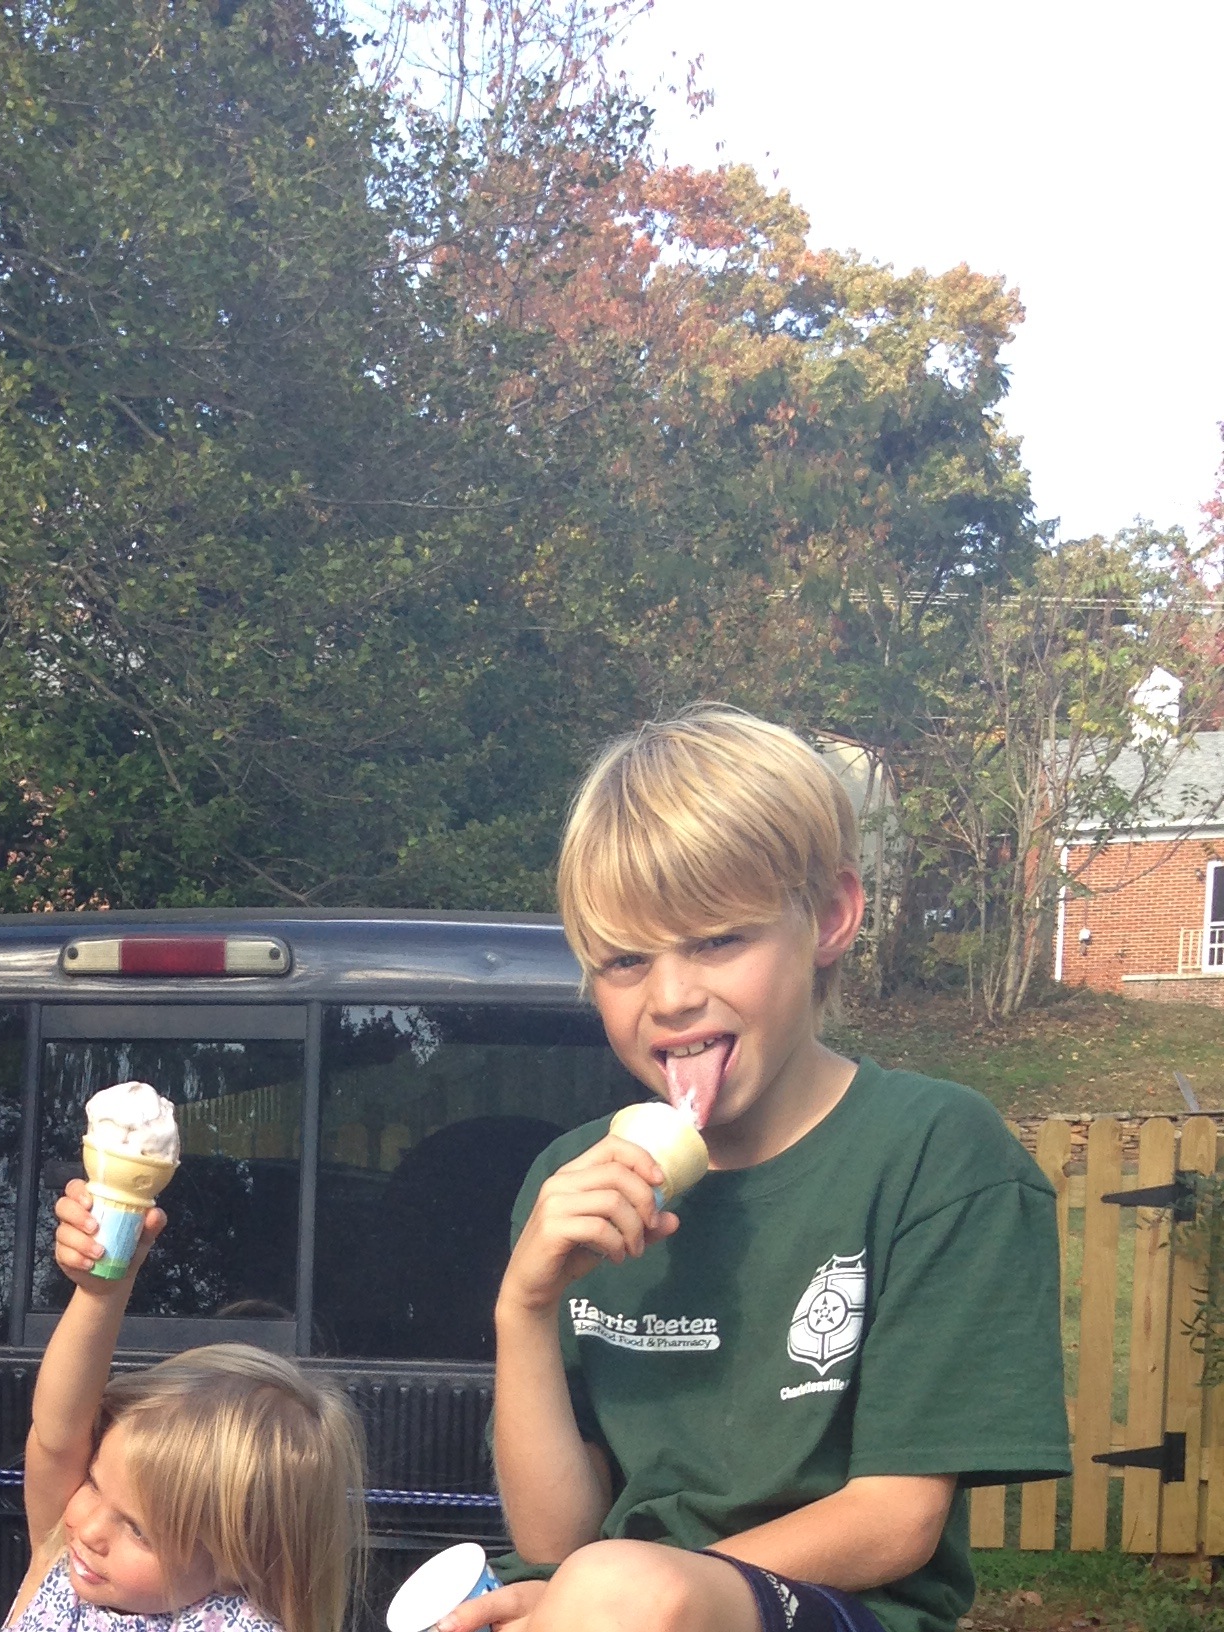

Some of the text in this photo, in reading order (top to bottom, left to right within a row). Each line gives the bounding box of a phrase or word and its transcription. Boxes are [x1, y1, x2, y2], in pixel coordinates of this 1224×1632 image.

[568, 1298, 638, 1334] Harris
[619, 1335, 644, 1348] Food
[646, 1337, 656, 1347] &
[656, 1338, 712, 1350] Pharmacy
